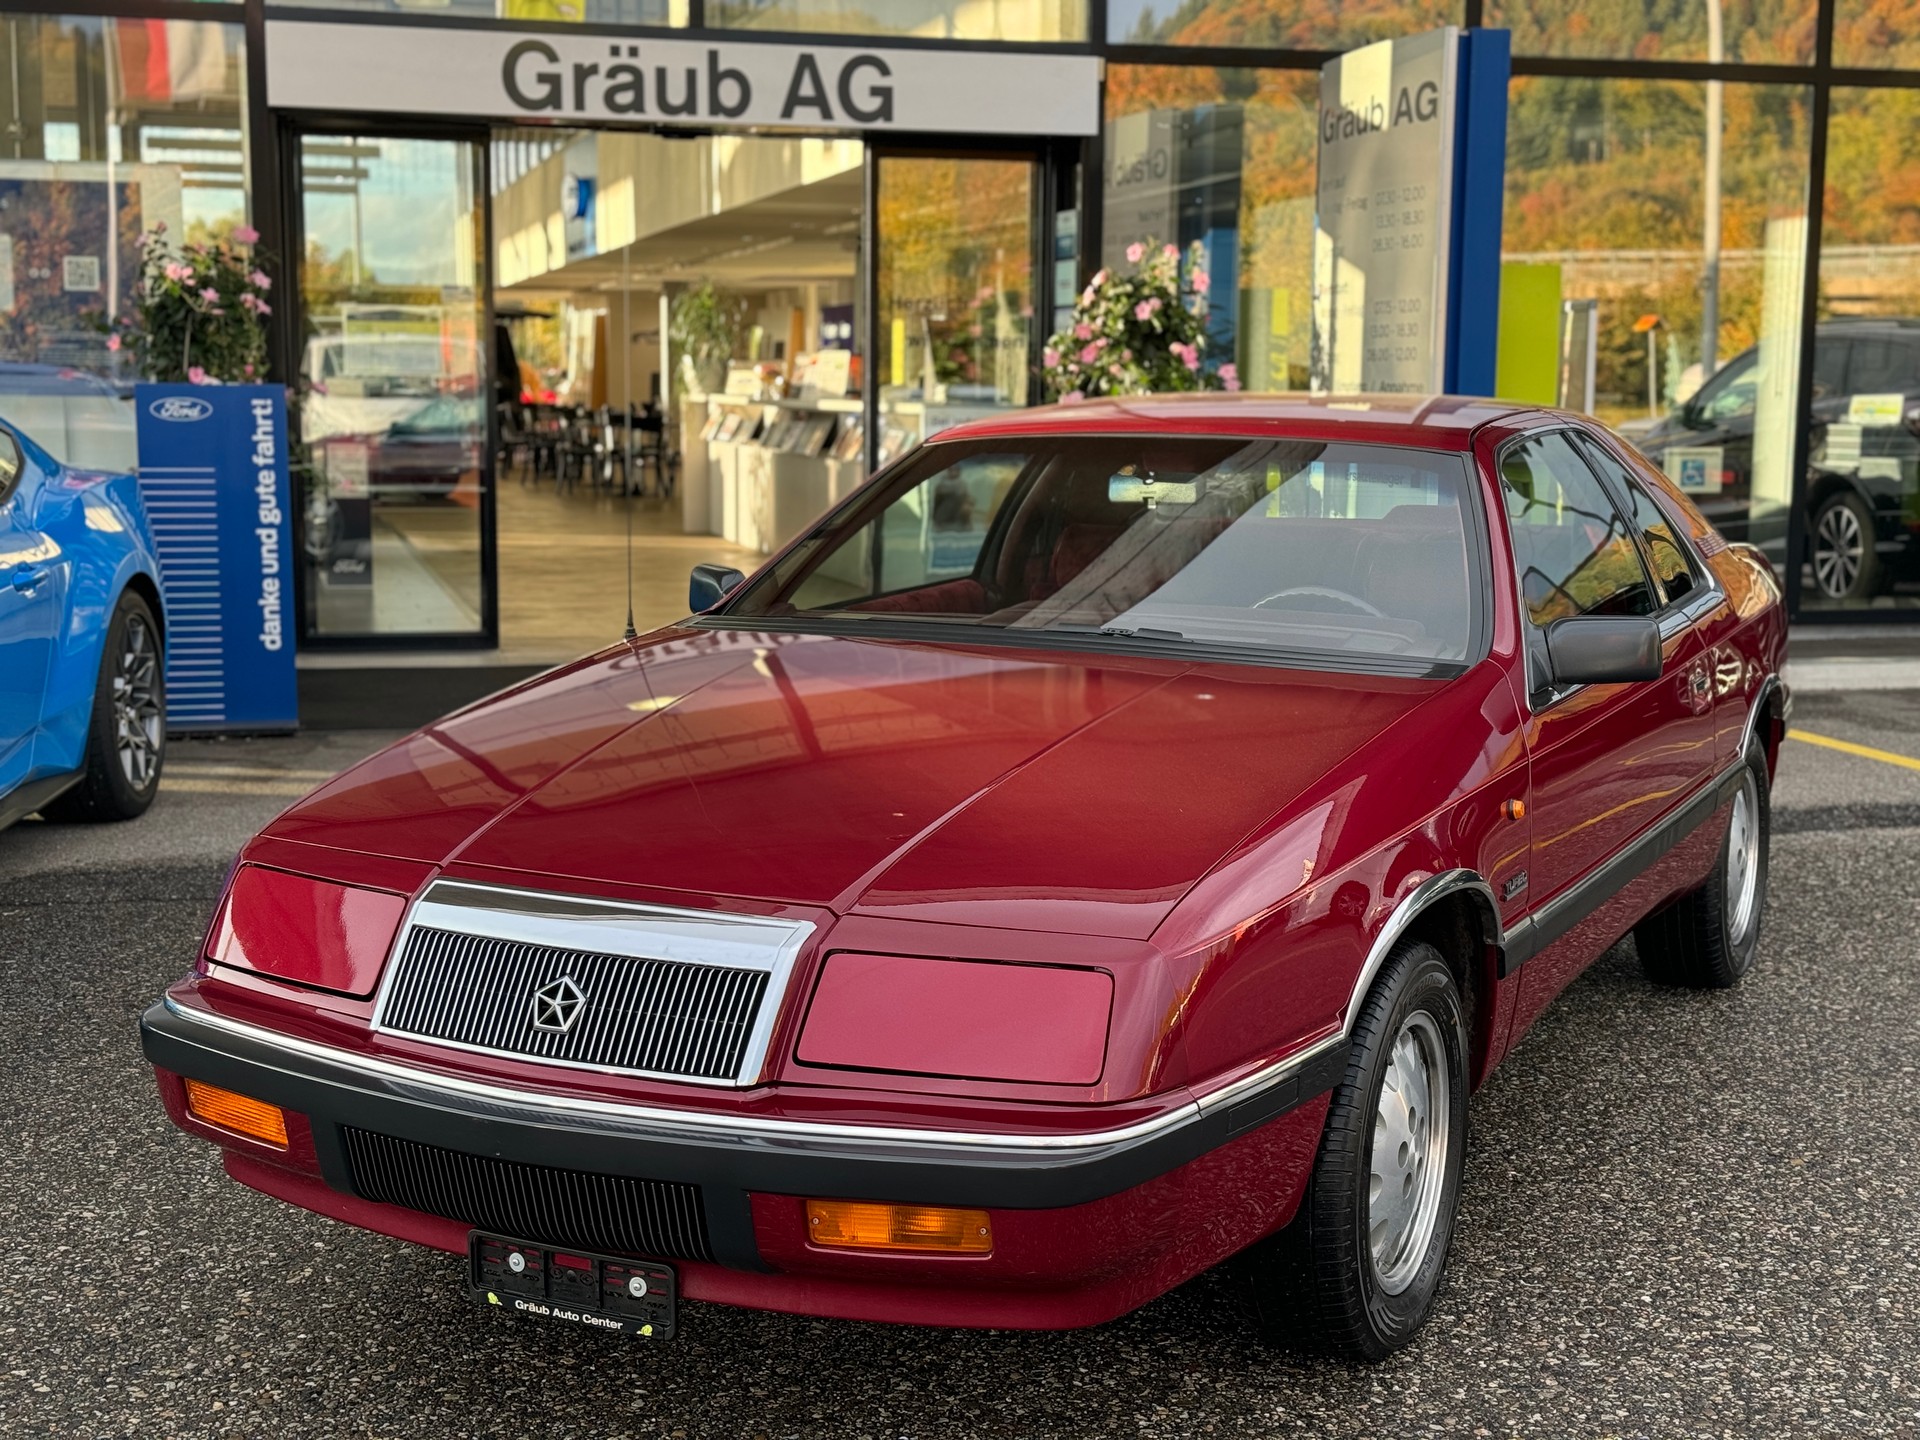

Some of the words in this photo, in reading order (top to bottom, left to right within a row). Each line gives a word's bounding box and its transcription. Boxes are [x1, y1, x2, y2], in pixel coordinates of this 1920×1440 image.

[502, 39, 752, 119] Gräub
[779, 53, 894, 123] AG
[1322, 94, 1384, 144] Gräub
[1393, 81, 1438, 127] AG
[160, 400, 202, 419] Ford
[251, 398, 276, 465] fahrt!
[255, 469, 282, 525] gute
[256, 528, 280, 575] und
[258, 577, 282, 650] danke
[514, 1300, 550, 1315] Gräub
[552, 1308, 580, 1321] Auto
[582, 1314, 623, 1330] Center
